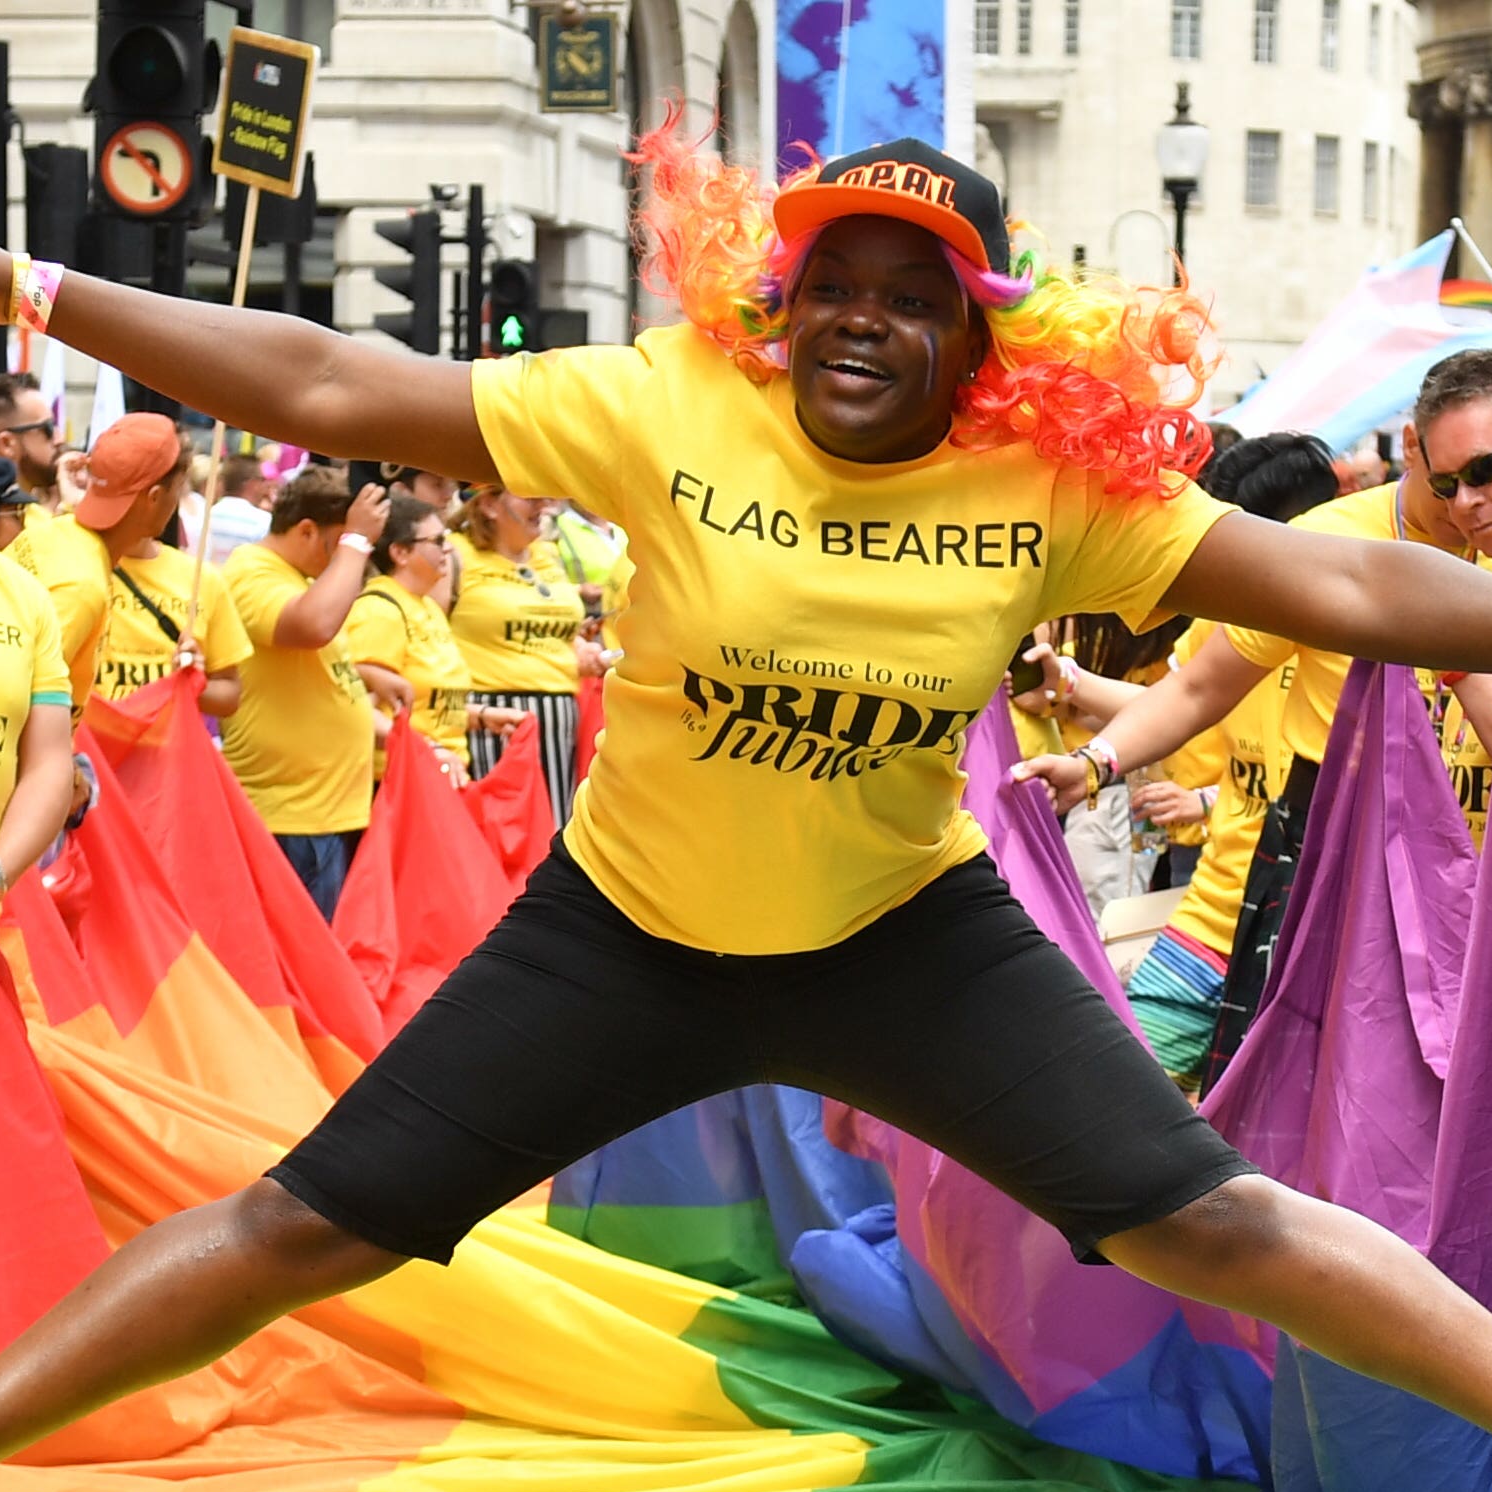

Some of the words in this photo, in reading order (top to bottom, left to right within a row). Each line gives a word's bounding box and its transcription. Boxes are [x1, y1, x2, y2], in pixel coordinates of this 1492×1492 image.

[672, 469, 799, 548] FLAG
[820, 520, 1043, 569] BEARER
[679, 661, 981, 755] PRIDE
[719, 645, 854, 680] Welcome
[865, 660, 893, 686] to
[903, 671, 953, 694] our
